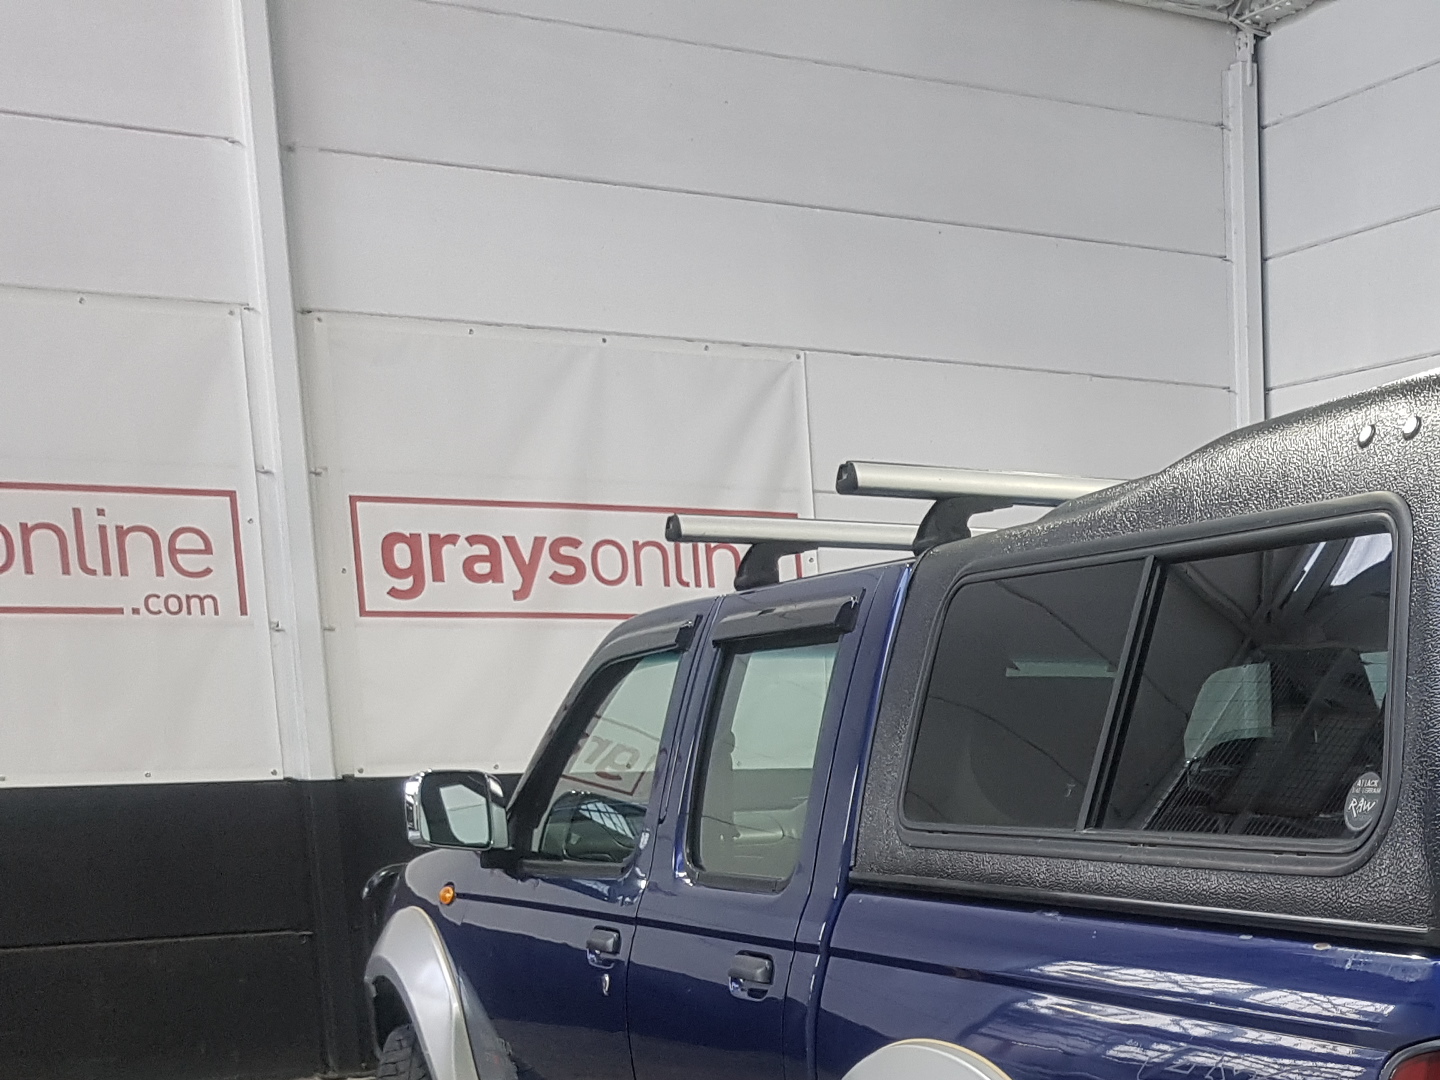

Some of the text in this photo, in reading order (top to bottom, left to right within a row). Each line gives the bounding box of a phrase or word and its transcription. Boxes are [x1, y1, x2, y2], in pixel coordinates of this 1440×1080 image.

[381, 531, 742, 602] graysonlin
[131, 592, 220, 616] .com
[1348, 798, 1376, 817] RAW
